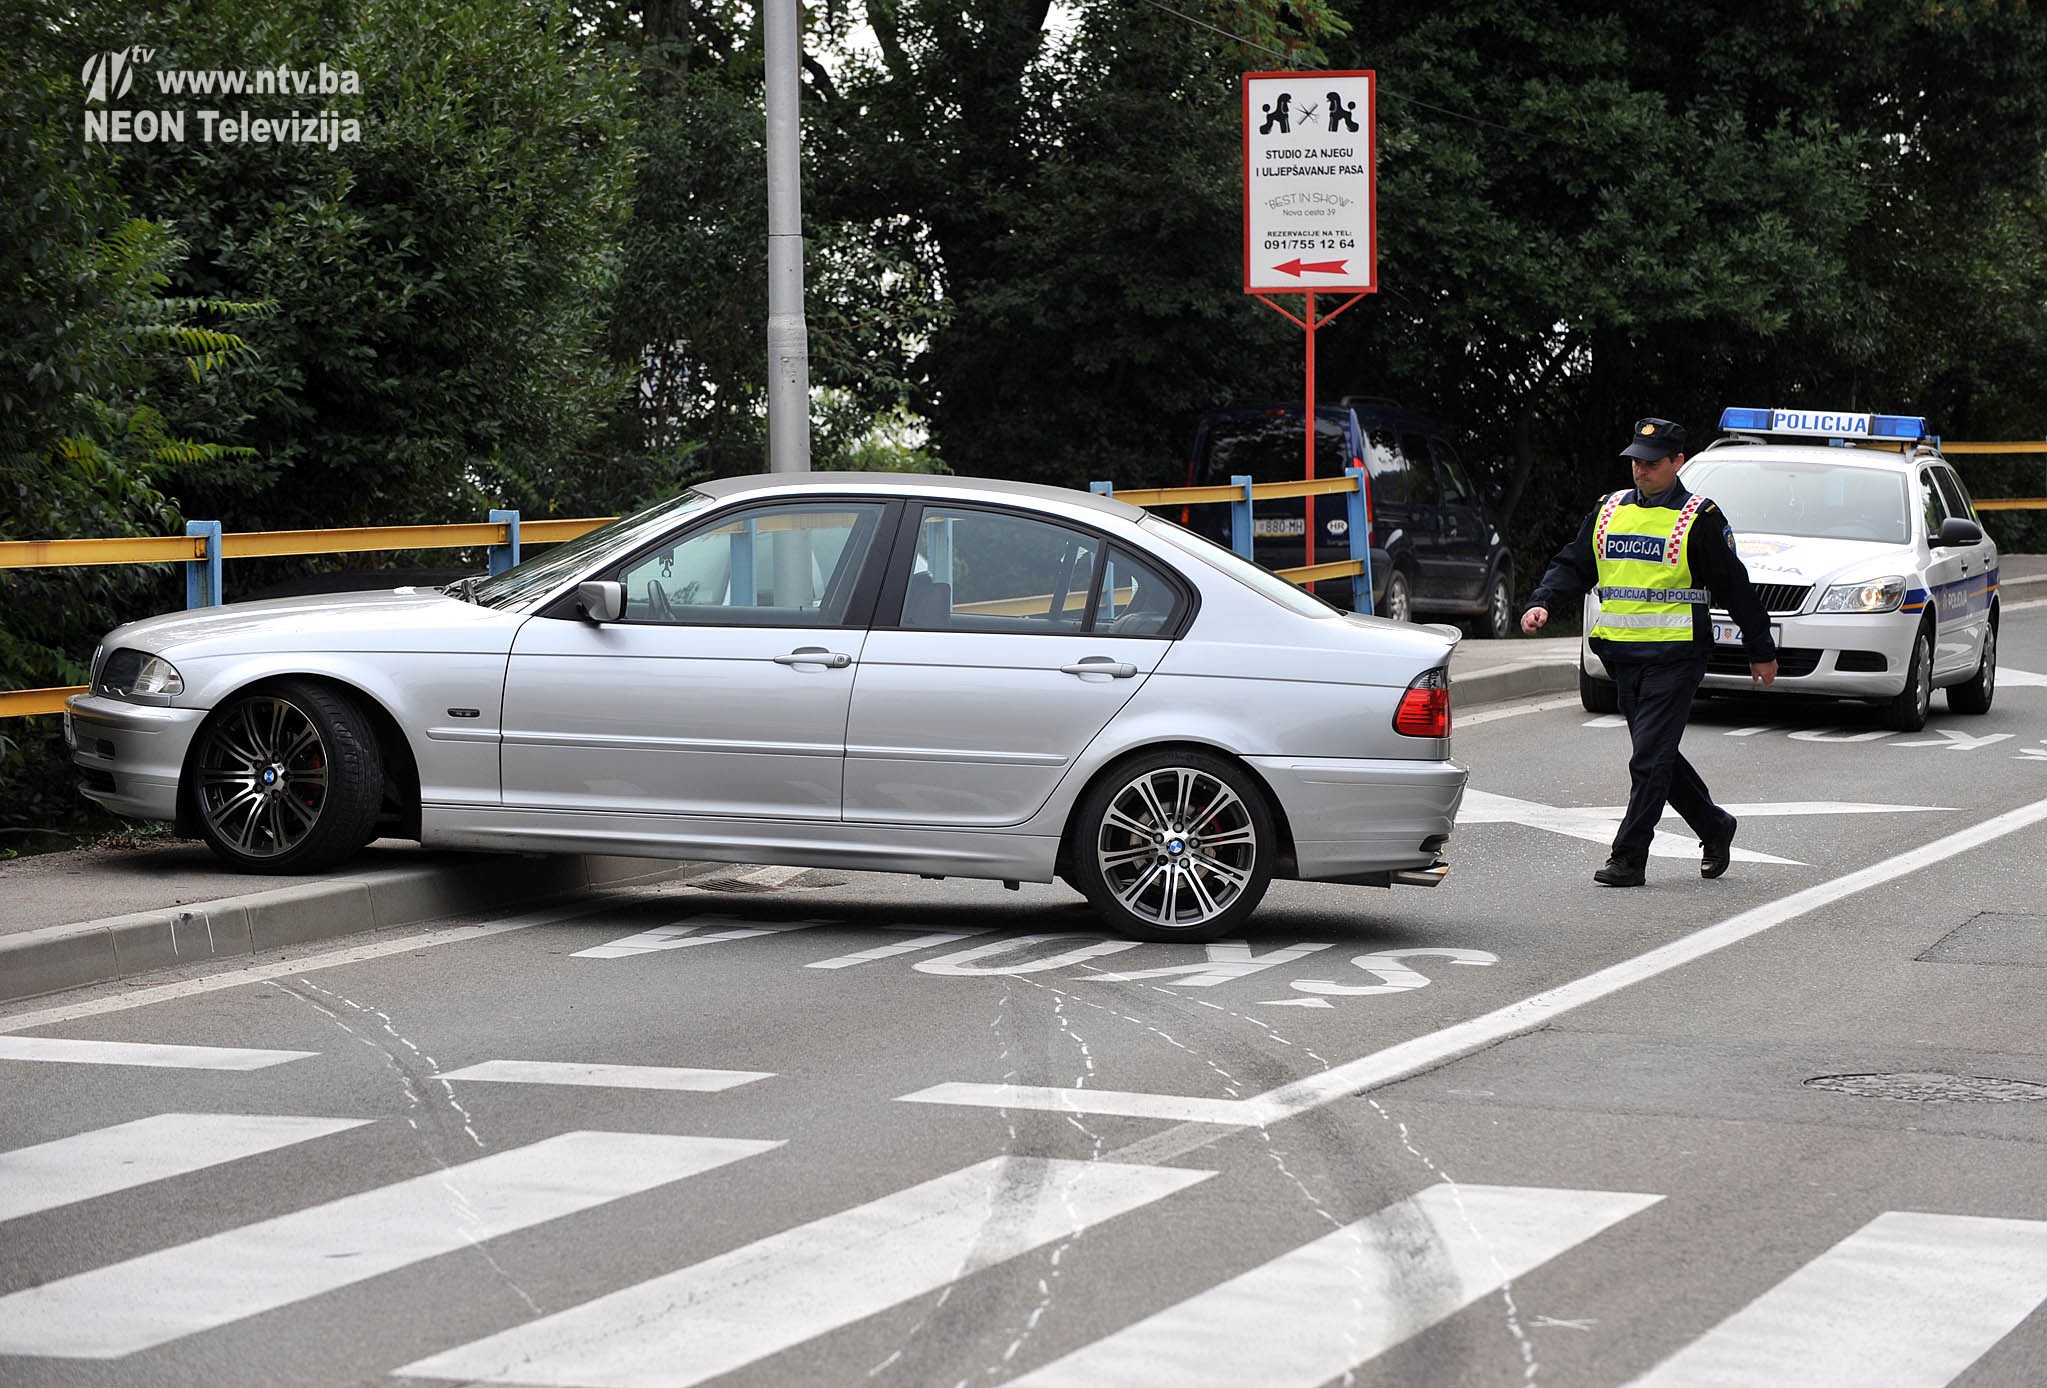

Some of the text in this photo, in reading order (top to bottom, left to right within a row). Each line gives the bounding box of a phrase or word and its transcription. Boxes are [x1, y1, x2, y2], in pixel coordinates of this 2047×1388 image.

[1265, 147, 1354, 160] STUDIO ZA NJEGU
[1262, 164, 1337, 177] ULJEPŠAVANJE
[1338, 165, 1364, 175] PASA
[1299, 192, 1311, 203] IN
[1282, 209, 1303, 217] Nova
[1326, 208, 1336, 216] 39
[1267, 230, 1320, 238] REZERVACIJE
[1264, 238, 1355, 250] 091/755 12 64
[1773, 413, 1867, 433] POLICIJA
[1329, 521, 1346, 530] HR
[1607, 540, 1662, 556] POLICIJA
[1610, 588, 1647, 600] POLICIJA
